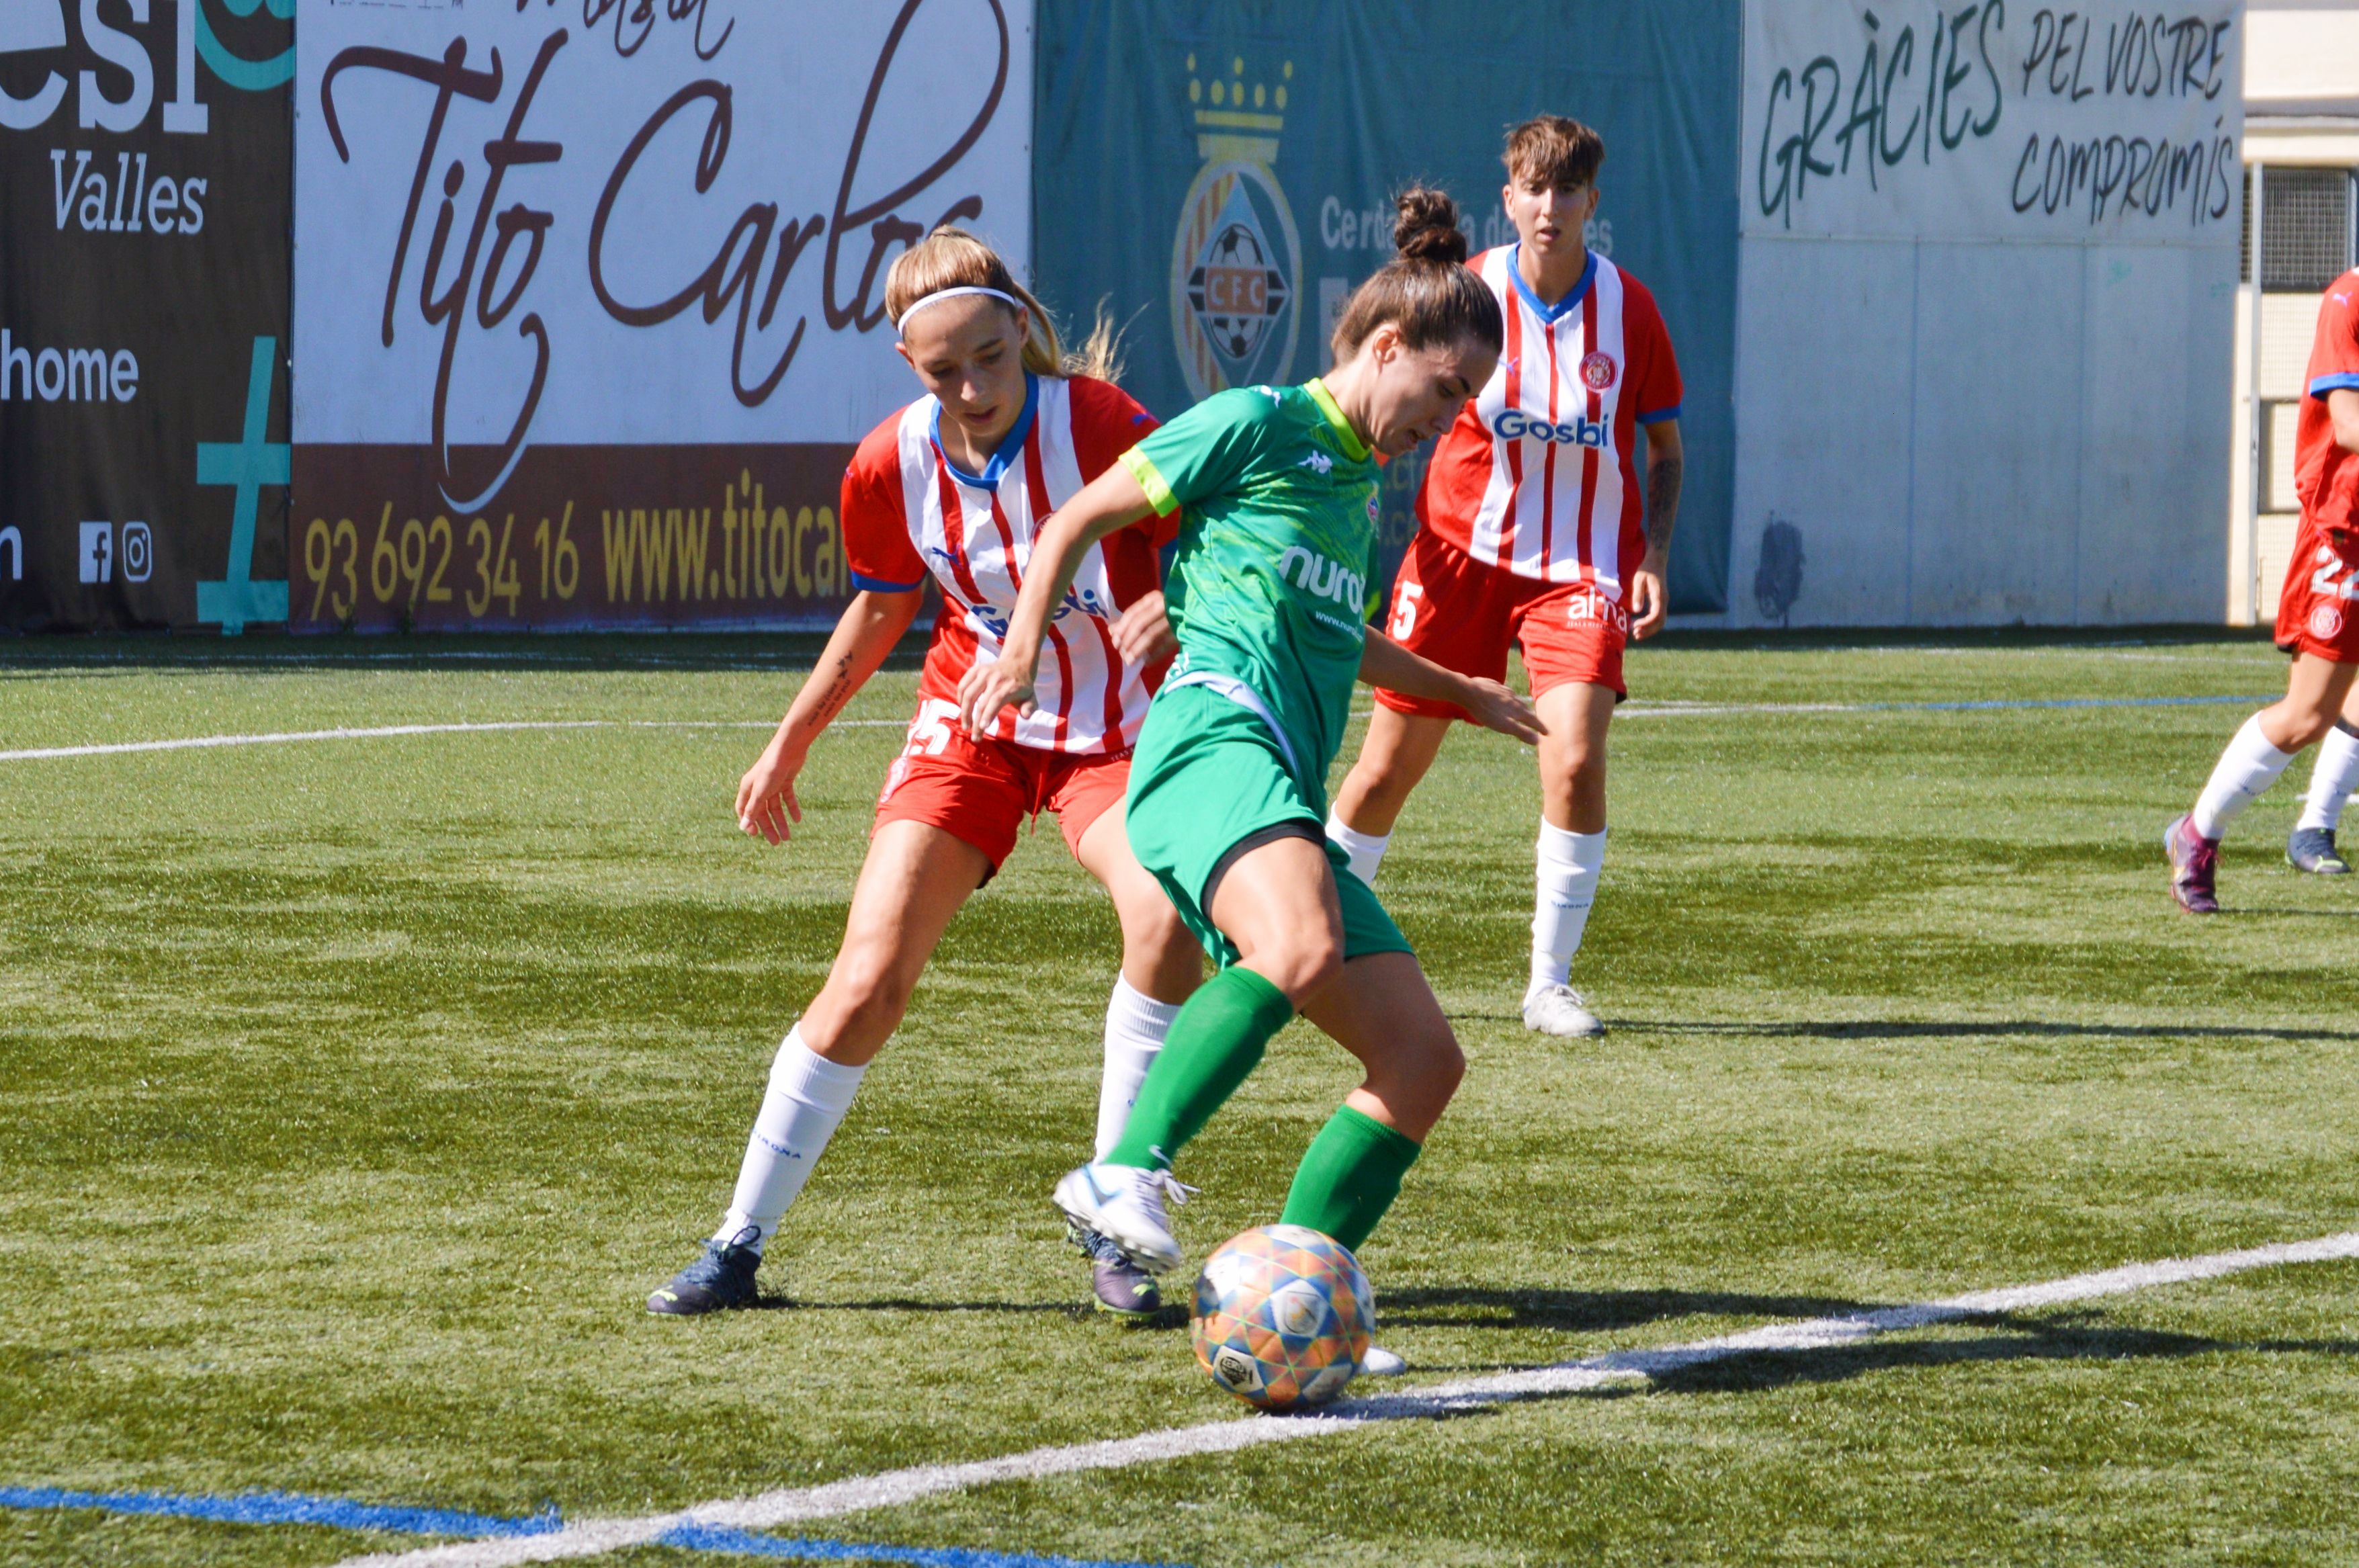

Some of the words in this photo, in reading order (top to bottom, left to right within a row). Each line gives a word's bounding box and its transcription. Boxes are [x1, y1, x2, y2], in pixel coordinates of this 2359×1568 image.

[2022, 8, 2094, 102] PEL
[2105, 10, 2231, 101] VOSTRE
[50, 149, 207, 234] Valles
[1, 328, 139, 402] home
[1494, 409, 1609, 447] Gosbi
[304, 518, 357, 622] 93
[371, 500, 454, 614] 692
[466, 513, 521, 619] 34
[535, 500, 579, 601] 16
[1392, 580, 1424, 640] 5
